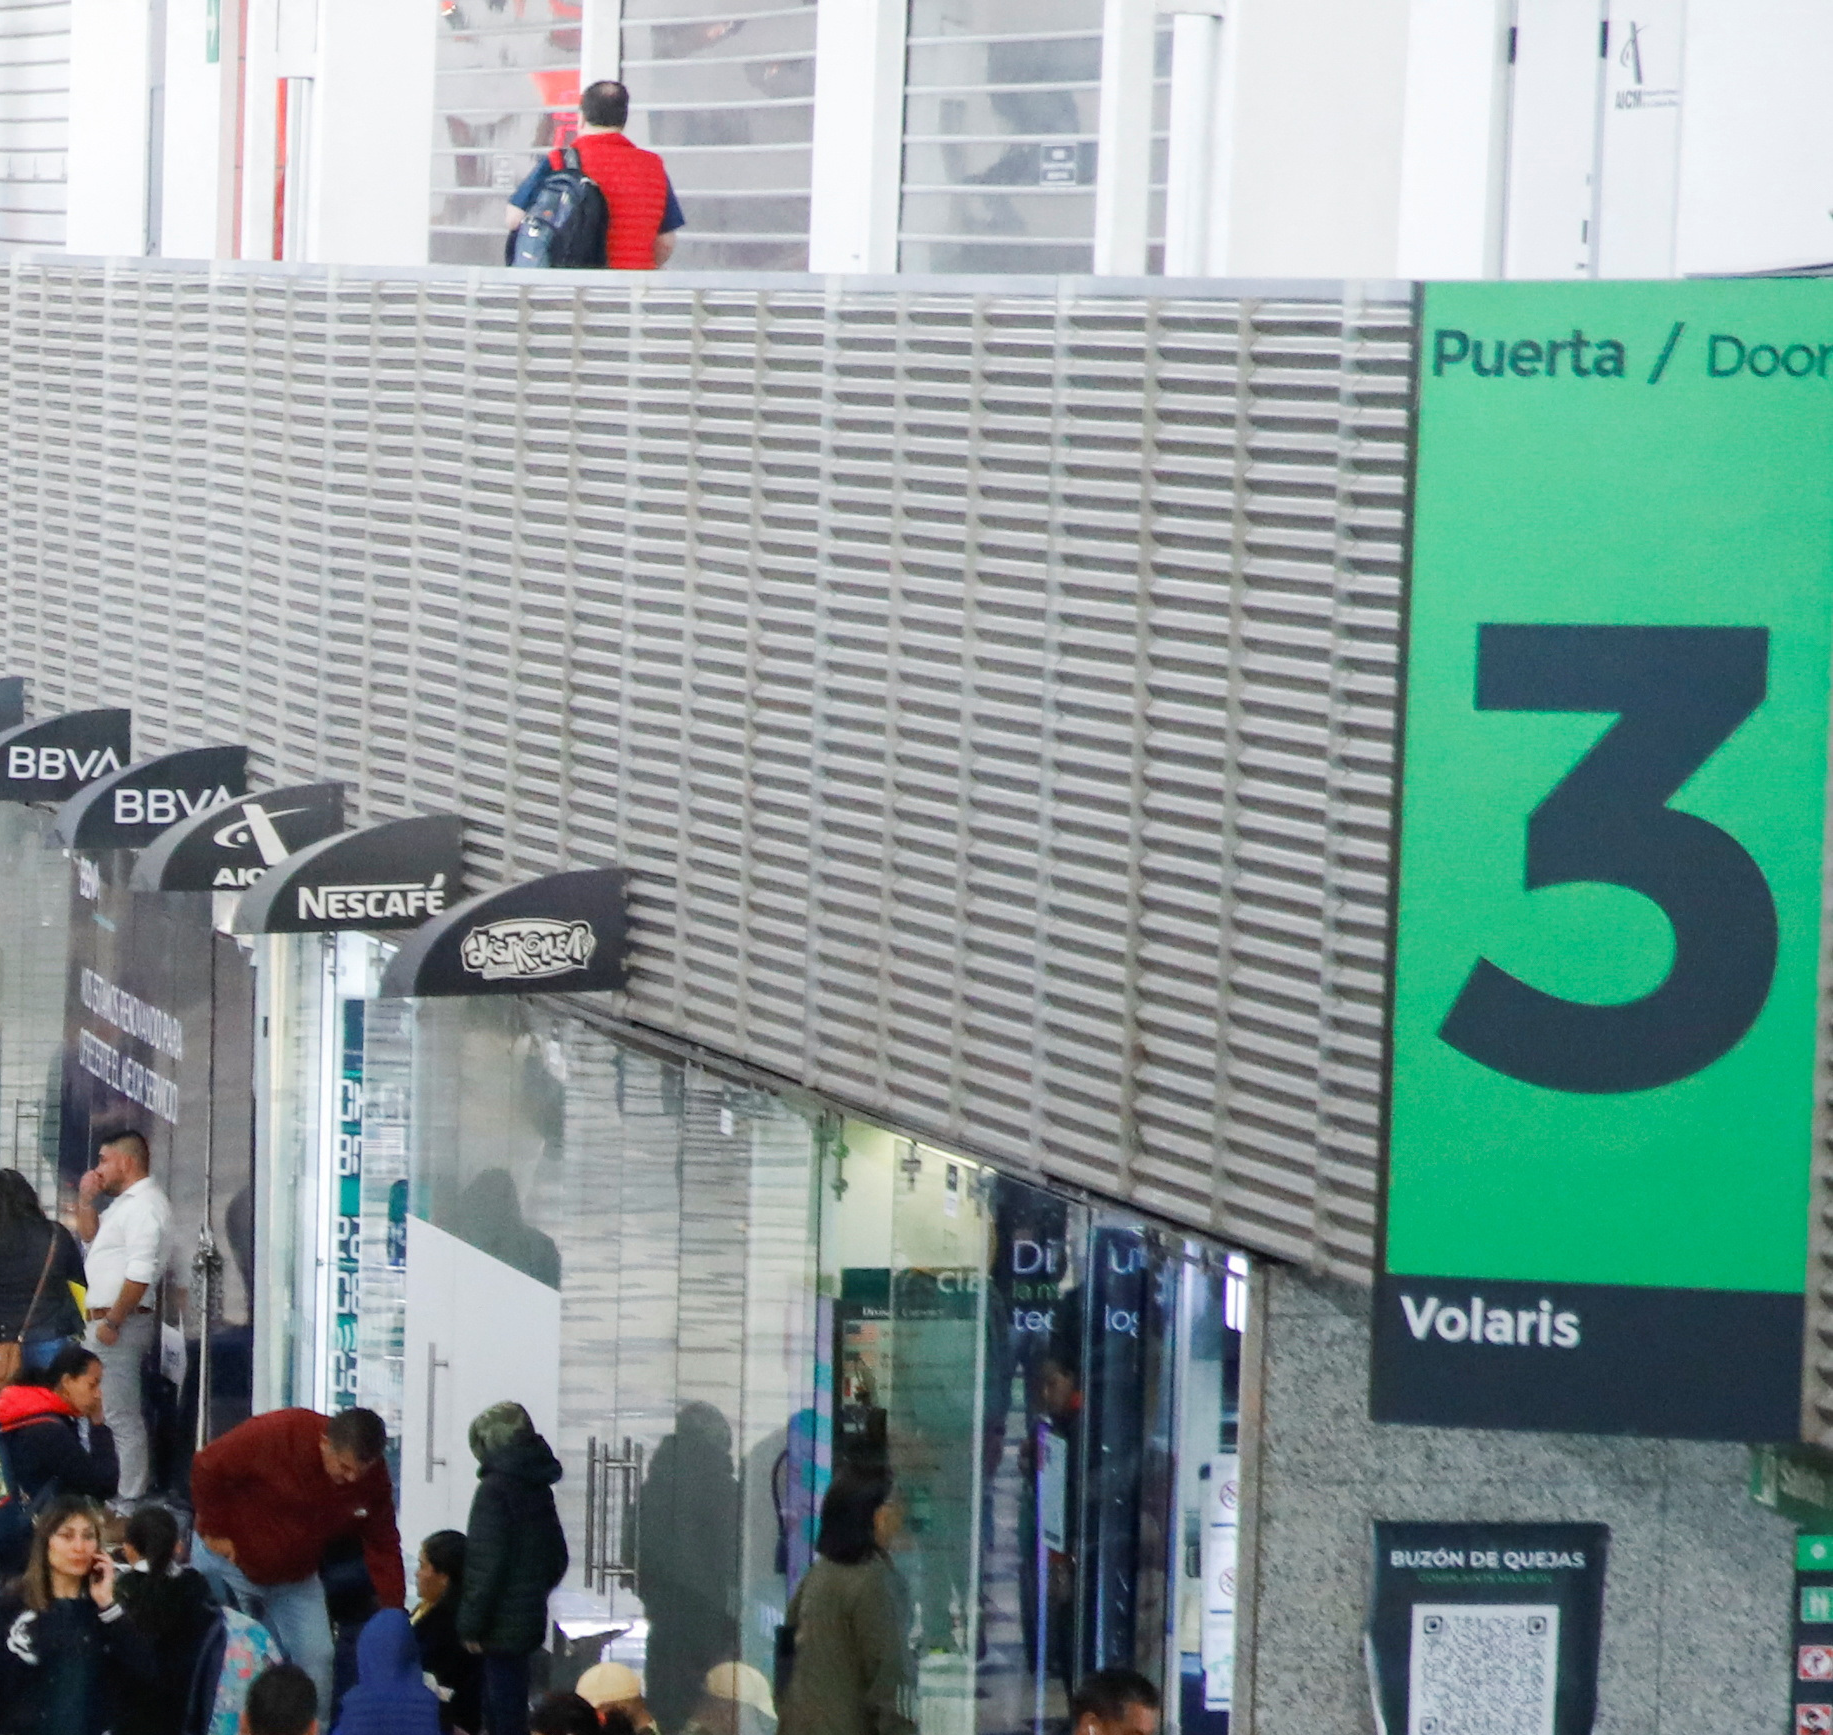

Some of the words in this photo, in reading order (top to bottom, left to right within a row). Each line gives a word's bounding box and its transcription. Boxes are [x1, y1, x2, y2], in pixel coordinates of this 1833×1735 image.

[1433, 328, 1625, 378] Puerta
[1646, 321, 1685, 385] /
[1708, 333, 1833, 378] Door
[8, 745, 121, 782] BBVA
[212, 867, 268, 887] AIC
[1437, 622, 1778, 1095] 3
[1399, 1295, 1582, 1349] Volaris
[1390, 1547, 1465, 1569] BUZÓN
[1470, 1551, 1500, 1569] DE
[1503, 1551, 1586, 1571] QUEJAS
